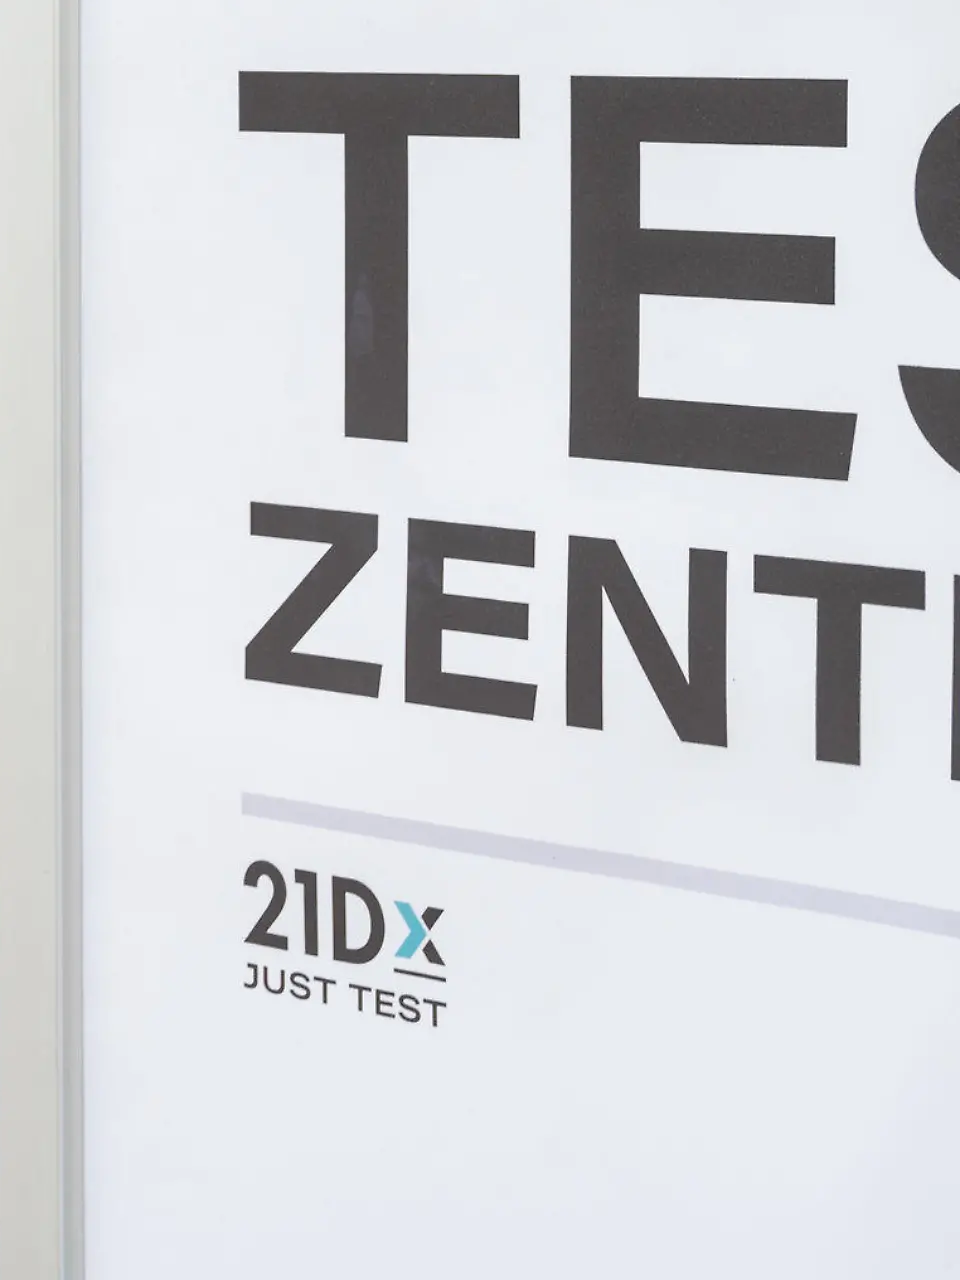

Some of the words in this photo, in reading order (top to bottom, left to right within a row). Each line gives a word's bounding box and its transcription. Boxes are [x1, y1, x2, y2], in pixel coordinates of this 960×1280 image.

[238, 70, 960, 482] TE
[244, 501, 960, 782] ZENT
[243, 962, 337, 1005] JUST
[348, 983, 447, 1028] TEST
